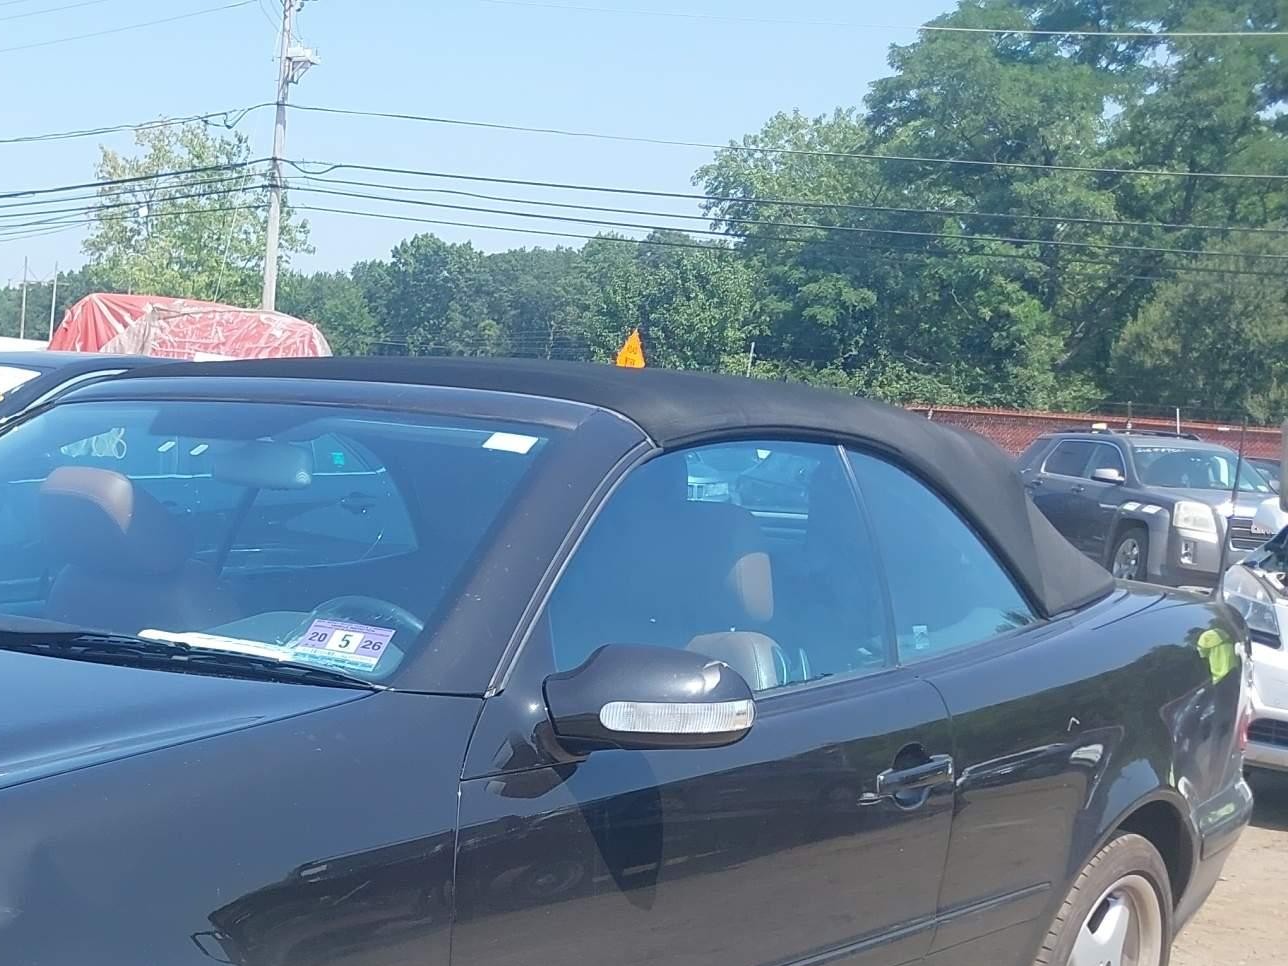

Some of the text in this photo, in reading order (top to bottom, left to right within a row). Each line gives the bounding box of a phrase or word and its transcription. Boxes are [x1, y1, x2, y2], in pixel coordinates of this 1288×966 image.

[308, 631, 383, 651] 20 5 26
